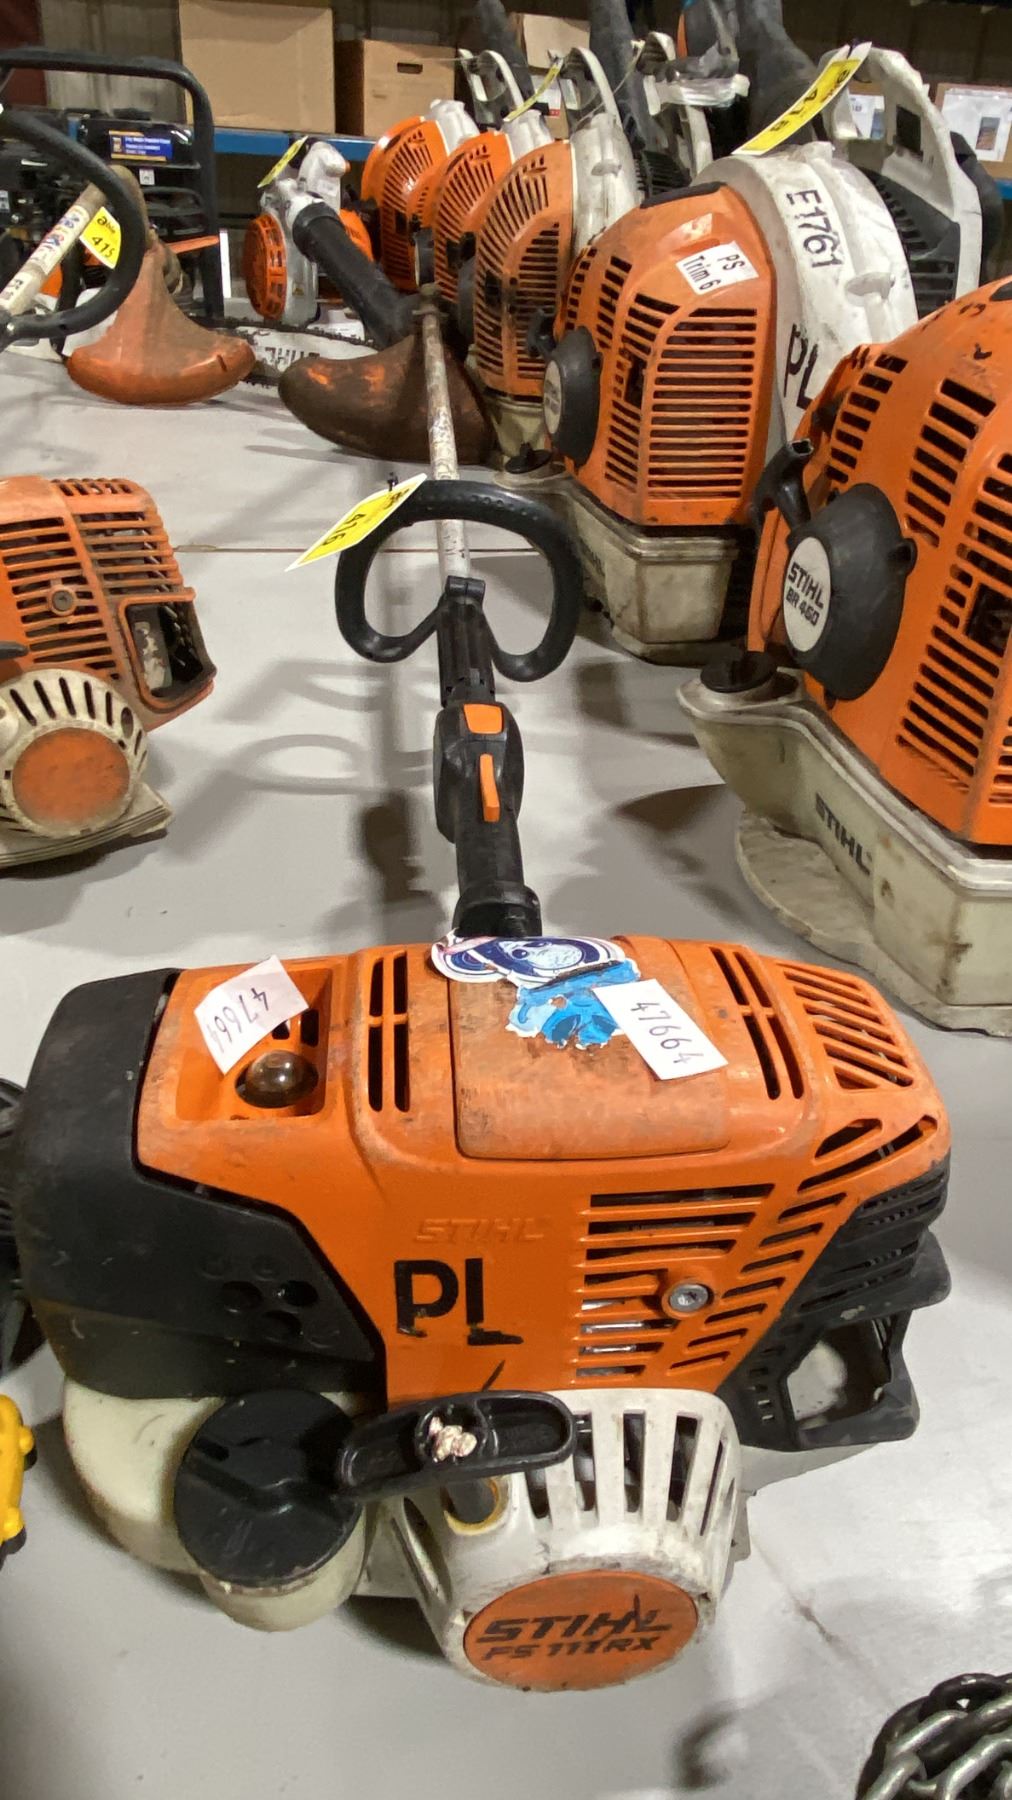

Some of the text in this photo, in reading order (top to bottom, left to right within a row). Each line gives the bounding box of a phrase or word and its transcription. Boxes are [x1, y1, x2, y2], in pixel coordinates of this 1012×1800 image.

[92, 236, 116, 258] 415
[786, 190, 844, 268] E1761
[683, 255, 722, 291] Trim 6
[717, 254, 746, 271] PS
[783, 323, 819, 410] PL
[785, 586, 820, 626] BR 460
[788, 561, 824, 610] STIHL
[815, 792, 871, 877] STIHL
[206, 987, 269, 1054] 47664
[630, 1001, 703, 1066] 47664
[413, 1218, 545, 1244] STIHL
[394, 1257, 524, 1346] PL
[476, 1609, 672, 1643] STIHL
[477, 1644, 540, 1661] FS
